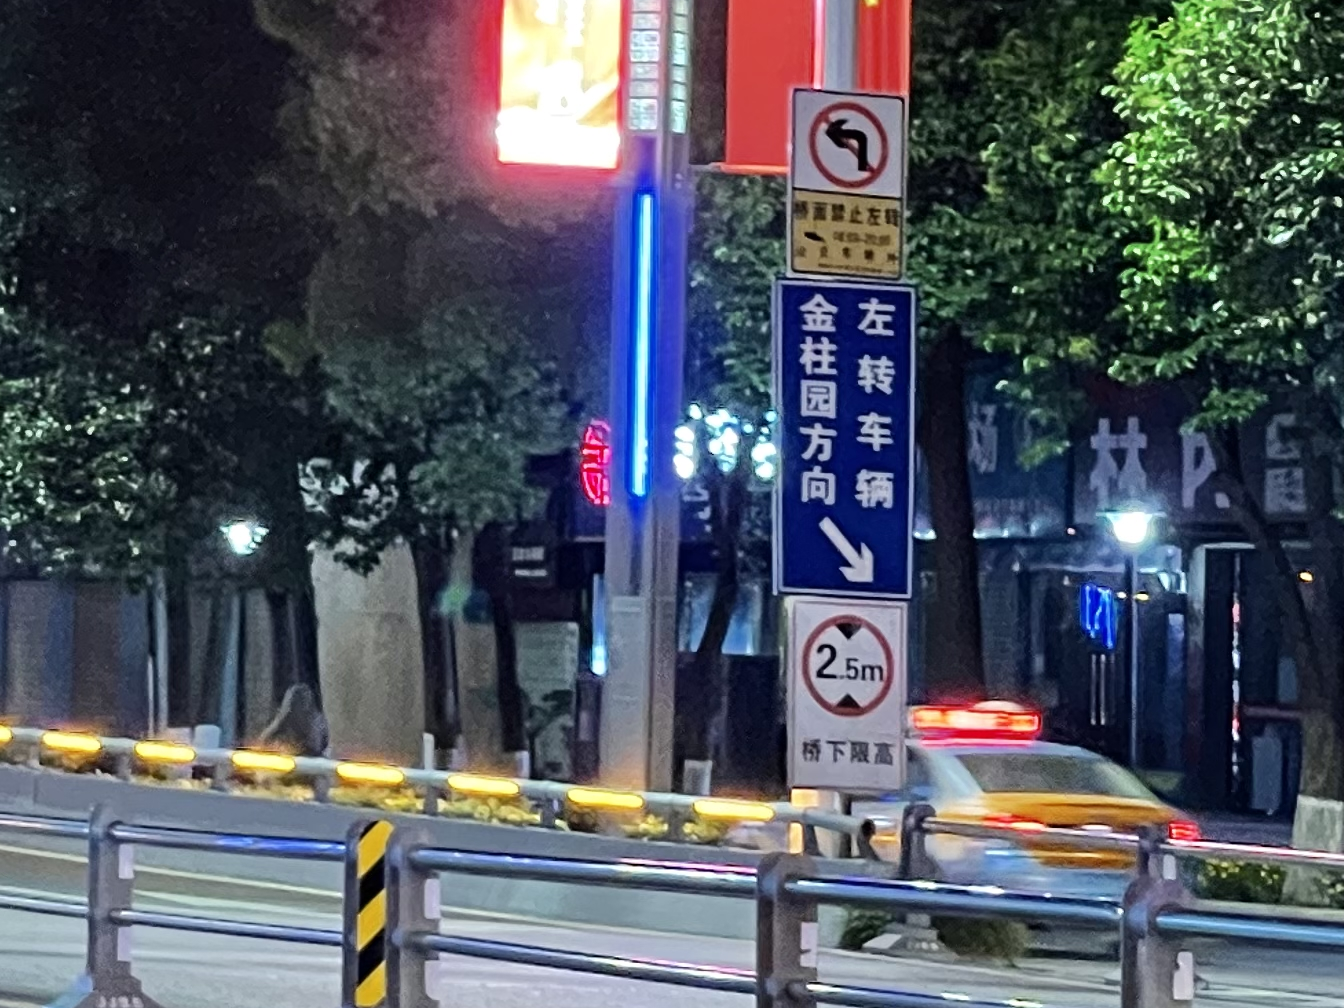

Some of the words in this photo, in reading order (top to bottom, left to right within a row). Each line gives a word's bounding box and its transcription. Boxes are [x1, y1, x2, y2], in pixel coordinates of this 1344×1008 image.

[799, 293, 839, 505] 金柱园方向
[855, 297, 896, 509] 左转车辆
[816, 643, 885, 682] 2.5m
[802, 739, 894, 766] 桥下限高
